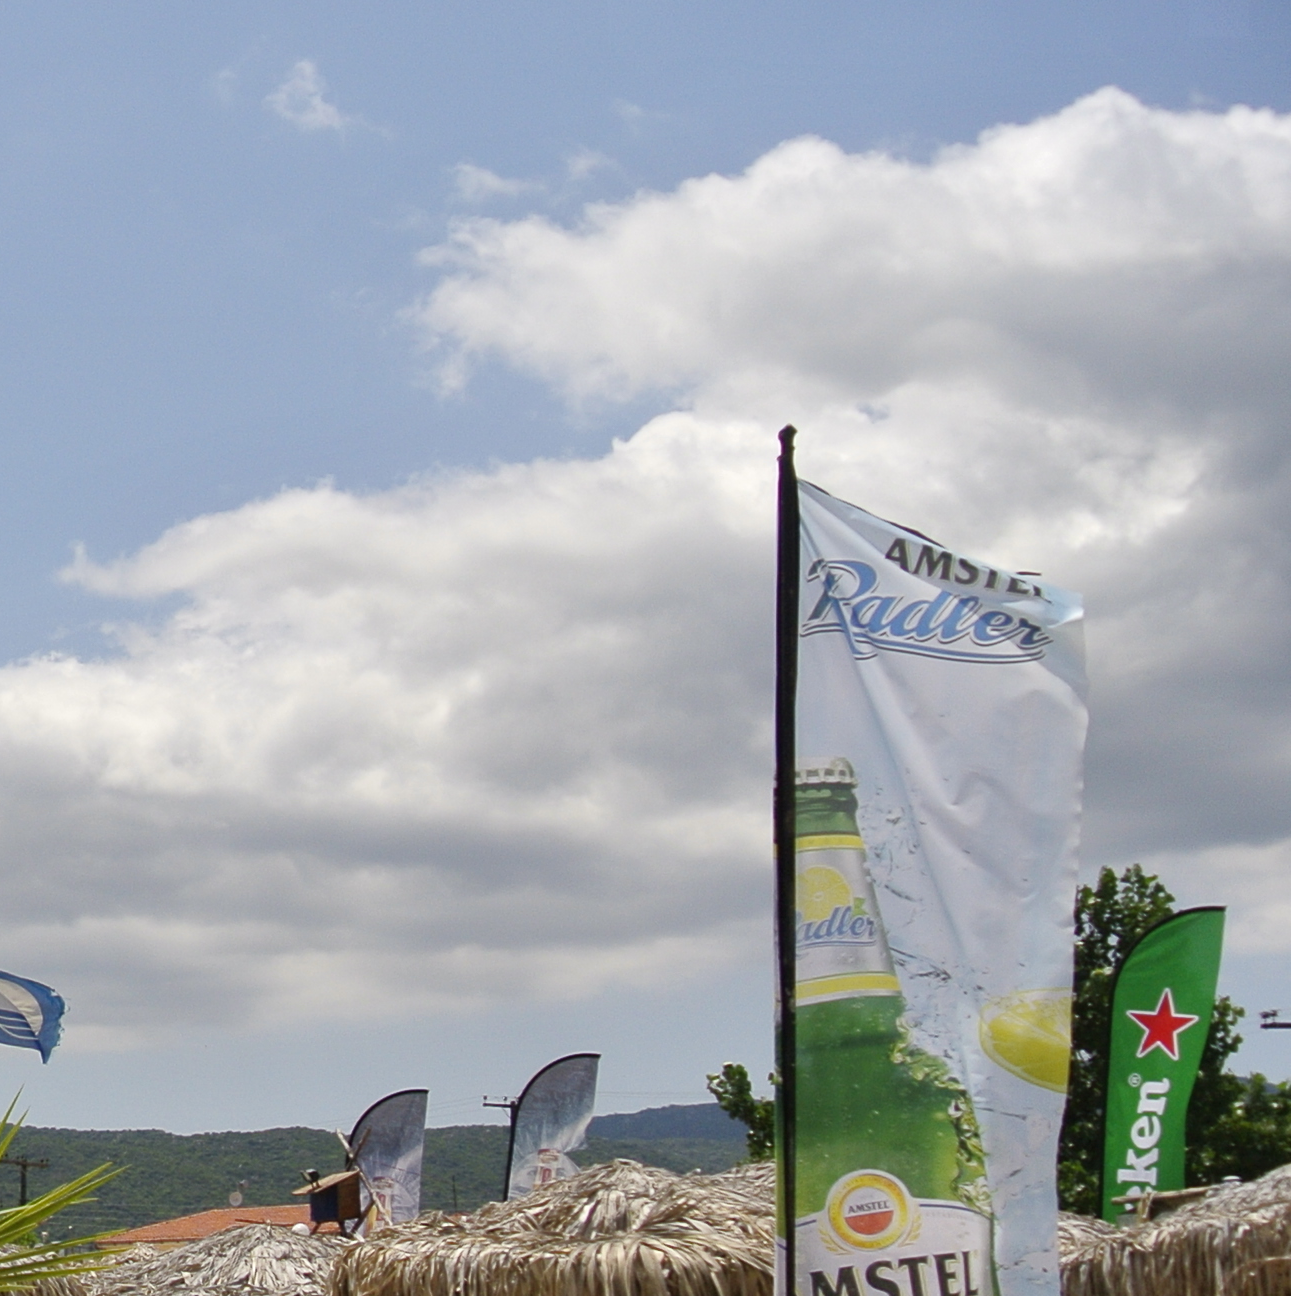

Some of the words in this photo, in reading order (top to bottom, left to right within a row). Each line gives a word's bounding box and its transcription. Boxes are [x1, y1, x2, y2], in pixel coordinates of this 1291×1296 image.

[800, 557, 1054, 662] Radler
[795, 905, 875, 943] adler
[1117, 1077, 1171, 1211] ken
[847, 1199, 890, 1215] AMSTEL
